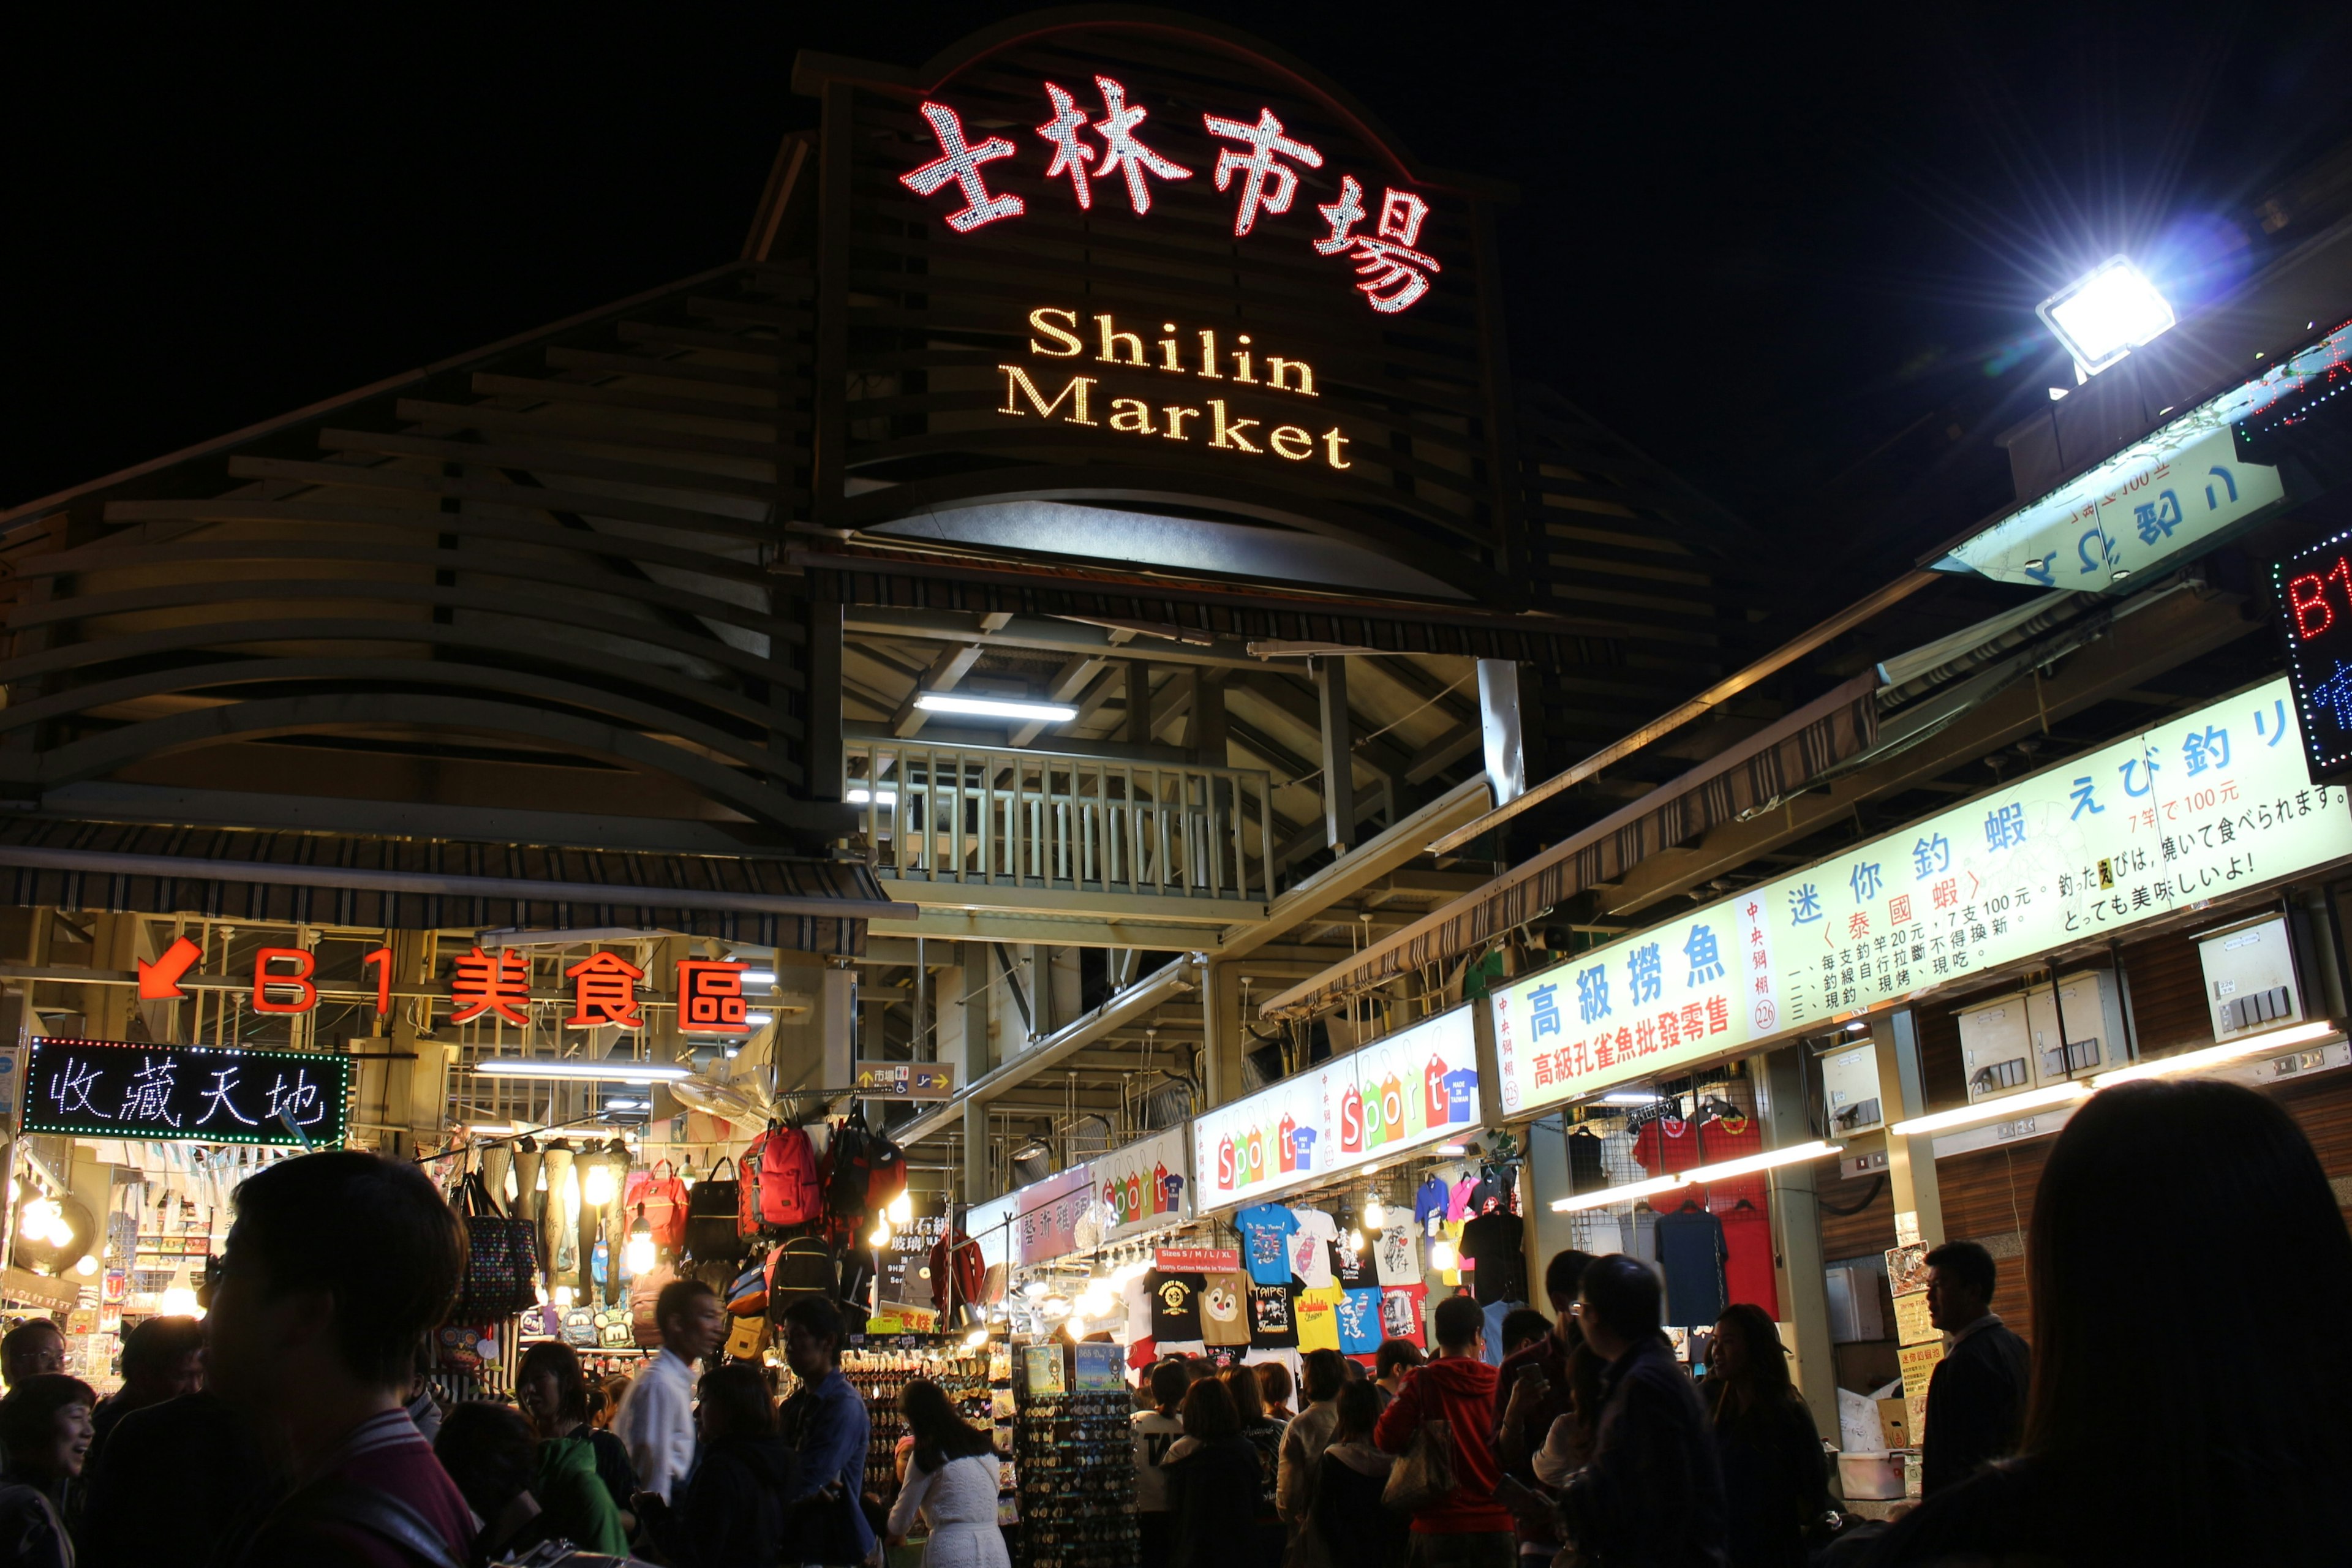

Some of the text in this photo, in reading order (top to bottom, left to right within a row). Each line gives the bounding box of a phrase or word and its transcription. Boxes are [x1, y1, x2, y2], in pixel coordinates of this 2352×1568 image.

[899, 75, 1441, 313] 士林市場
[1029, 307, 1319, 396] Shilin
[998, 364, 1351, 469] Market
[2069, 699, 2287, 821] えび釣り
[1787, 802, 2027, 927] 迷你釣蝦
[1526, 924, 1725, 1042] 高級撈魚
[1746, 900, 1769, 995] 中央鋼棚
[874, 1069, 894, 1082] 市場
[1499, 997, 1514, 1076] 中央鋼棚
[1532, 994, 1729, 1090] 高級孔雀魚批發零售
[50, 1056, 325, 1127] 收藏天地
[1343, 1068, 1443, 1152] Sport
[1254, 1286, 1286, 1301] TAIPEI
